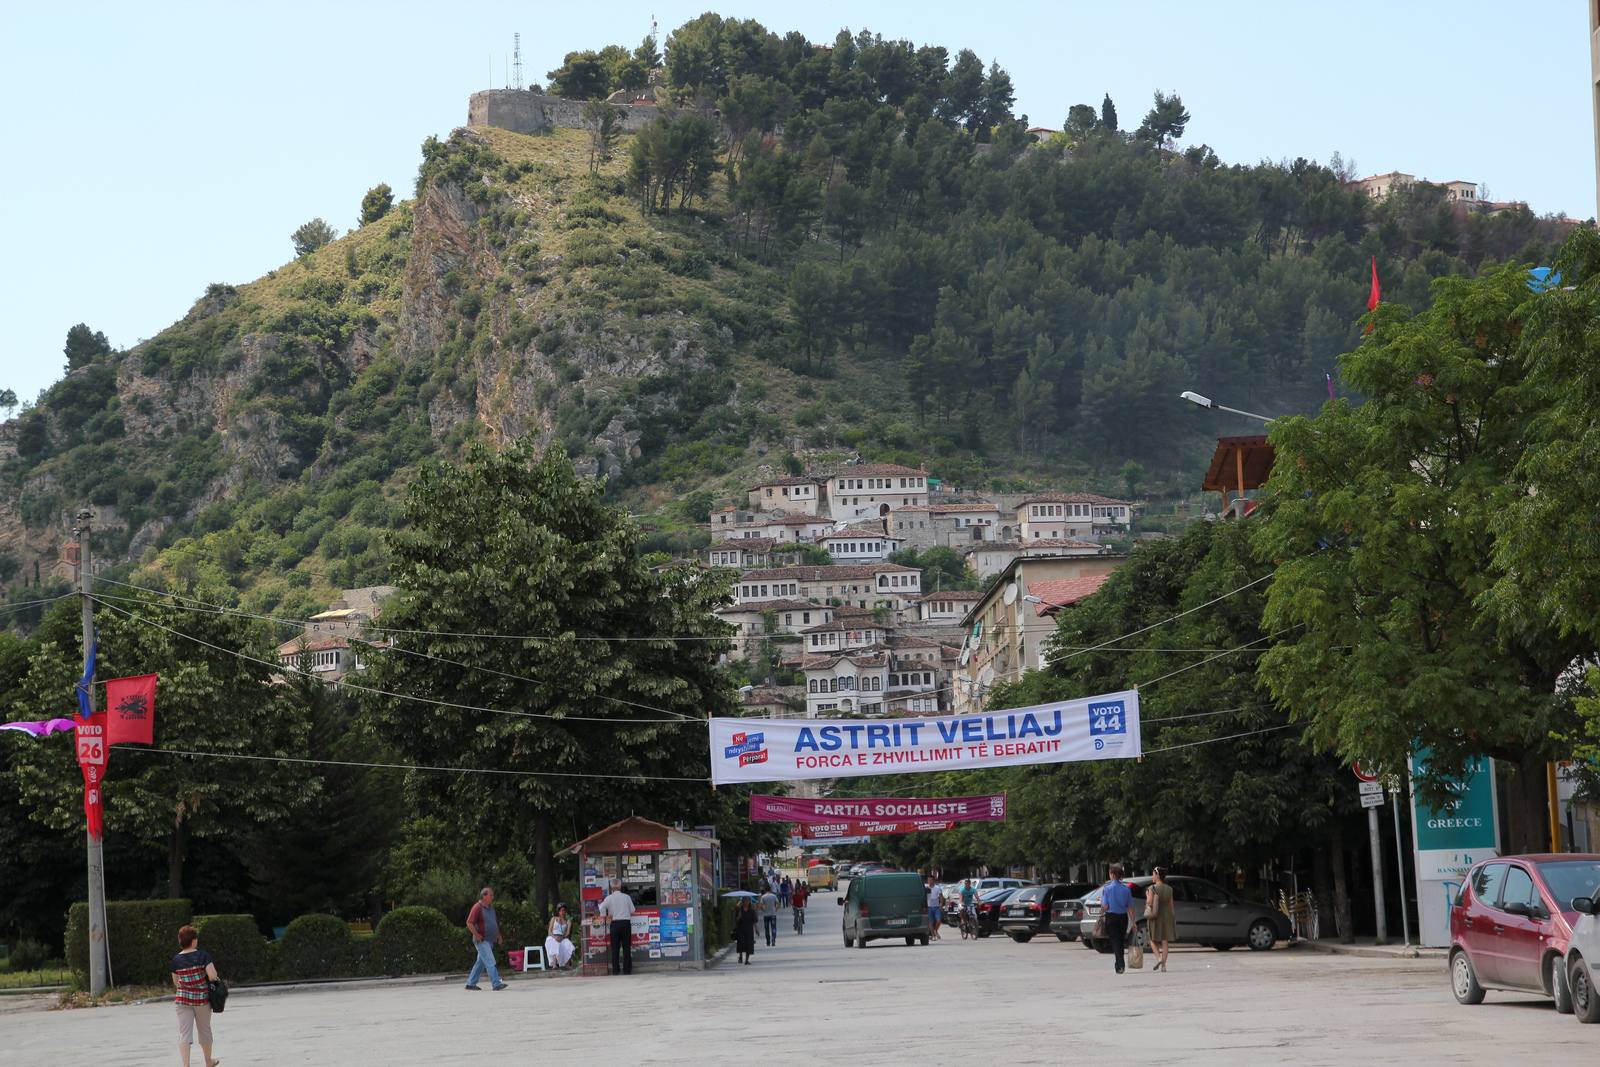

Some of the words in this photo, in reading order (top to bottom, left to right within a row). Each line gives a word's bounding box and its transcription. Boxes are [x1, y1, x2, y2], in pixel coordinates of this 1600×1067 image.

[1093, 706, 1120, 715] VOTO
[1094, 715, 1121, 731] 44
[78, 726, 102, 734] VOTO
[794, 723, 925, 752] ASTRIT
[936, 710, 1062, 743] VELIAJ
[80, 743, 101, 759] 26
[728, 744, 756, 754] ndryshimi
[742, 753, 766, 762] Përpara!
[796, 754, 852, 769] FORCA
[858, 754, 867, 765] E
[873, 748, 963, 764] ZHVILLIMIT
[968, 743, 988, 758] TË
[994, 740, 1061, 757] BERATIT
[815, 804, 870, 816] PARTIA
[875, 803, 967, 816] SOCIALISTE
[990, 808, 1004, 816] 29
[875, 824, 897, 832] SHPEJT
[1427, 818, 1482, 828] GREECE
